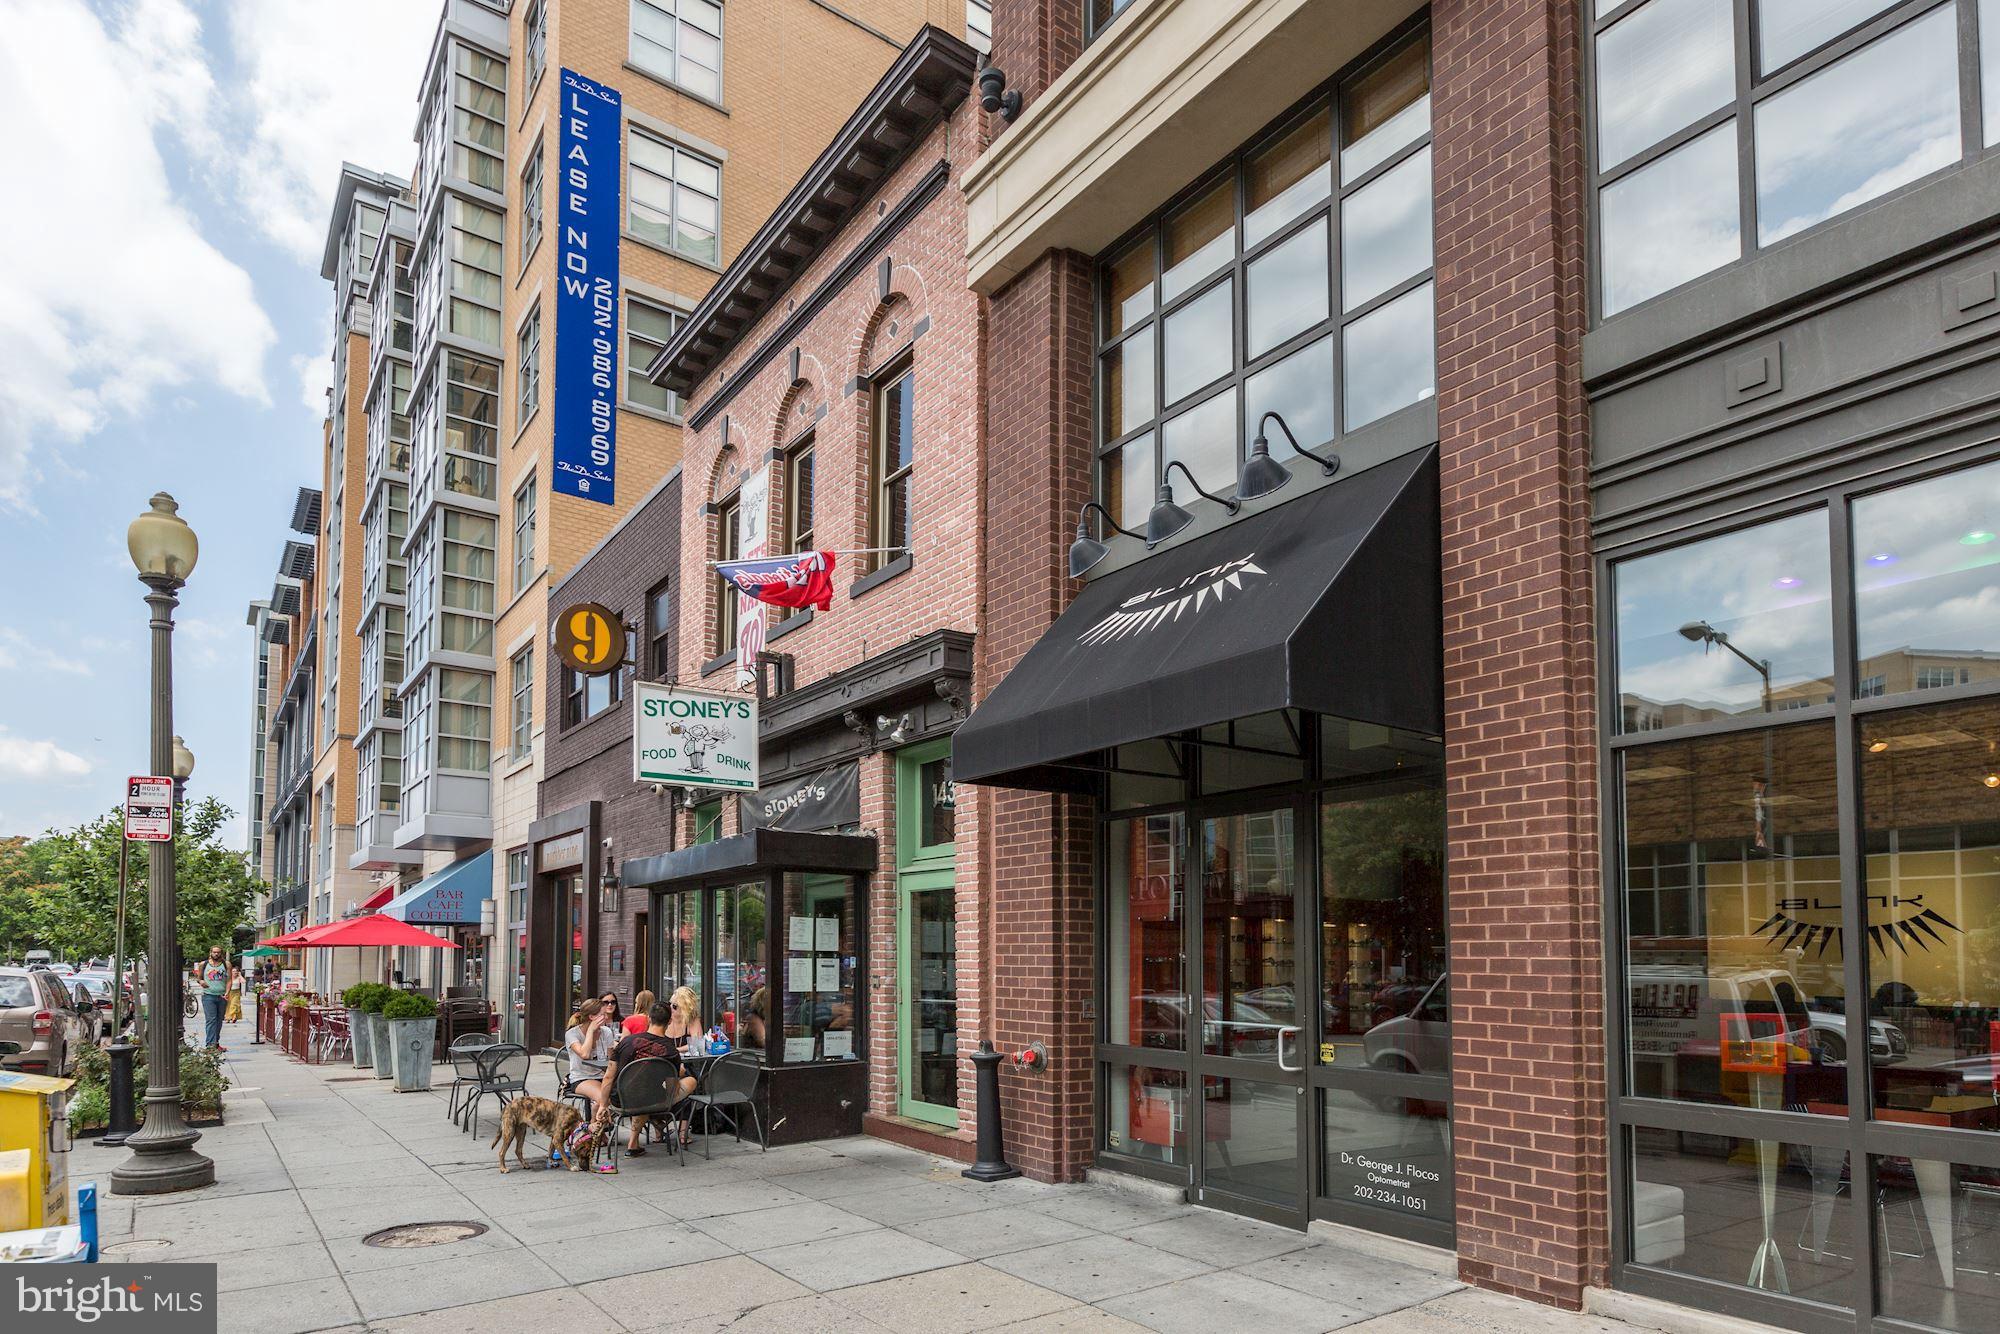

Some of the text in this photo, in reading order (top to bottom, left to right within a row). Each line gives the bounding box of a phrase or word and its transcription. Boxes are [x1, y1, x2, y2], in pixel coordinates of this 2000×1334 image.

[564, 93, 589, 299] LEASE NOW
[570, 610, 611, 665] 9
[644, 699, 750, 719] STONEY'S
[642, 748, 751, 771] FOOD DRINK
[131, 785, 139, 796] 2
[764, 784, 826, 817] STONEY'S
[436, 889, 463, 899] BAR
[1776, 895, 1923, 909] BLNK
[411, 910, 463, 920] COFFEE
[428, 900, 463, 910] CAFE
[1341, 1152, 1440, 1181] Dr. George J. Flocos
[1367, 1172, 1410, 1188] Optometrist
[1354, 1185, 1426, 1210] 202-234-1051
